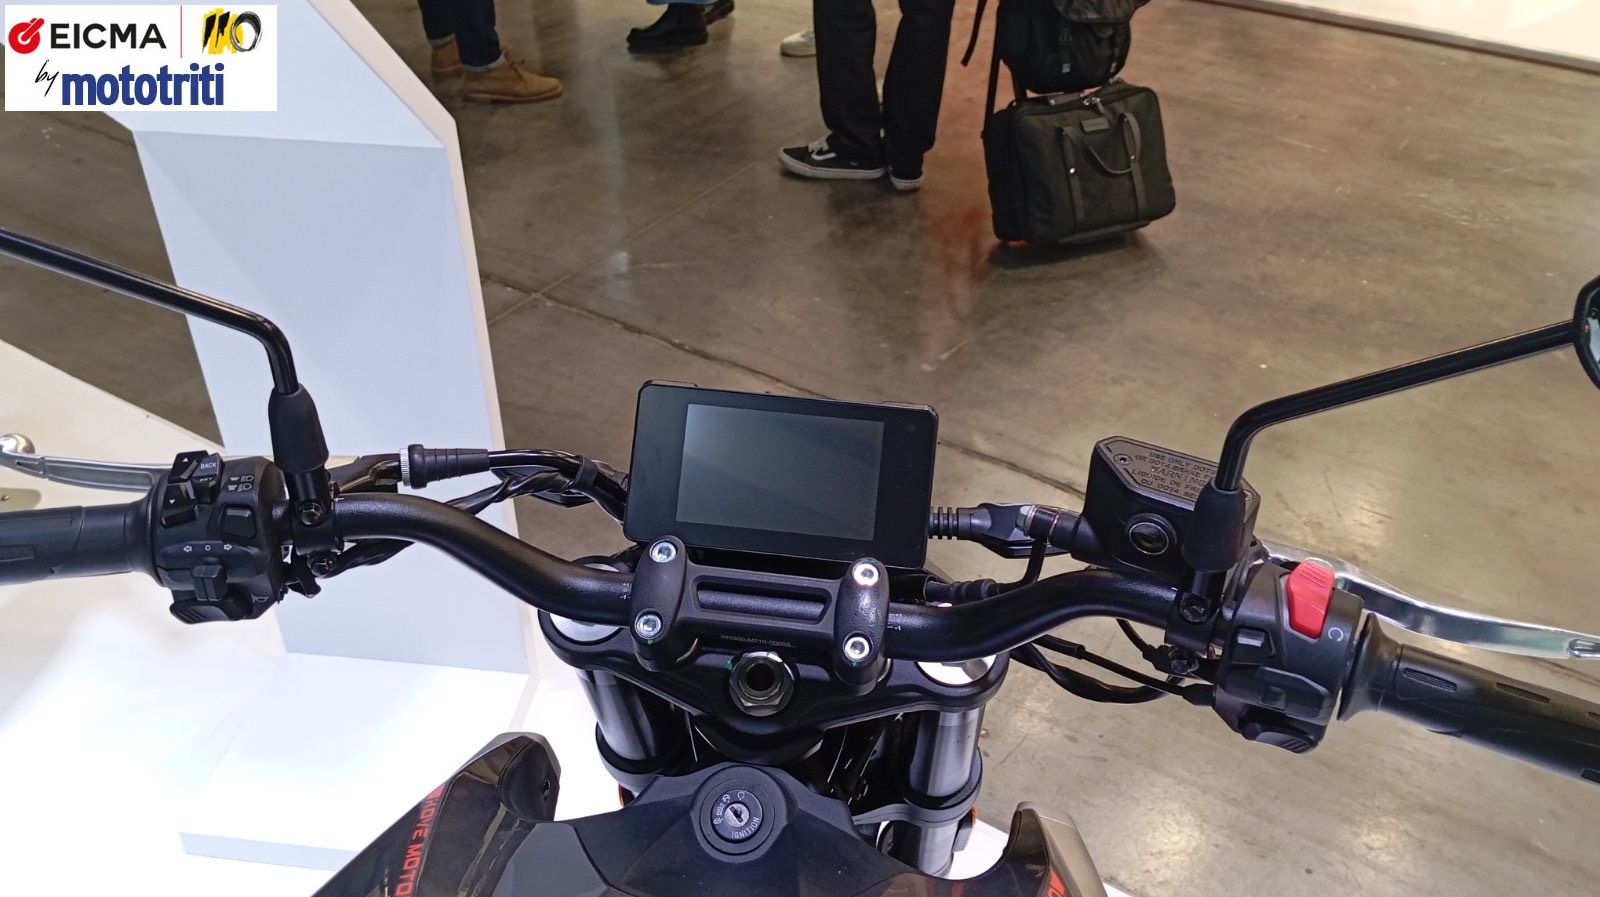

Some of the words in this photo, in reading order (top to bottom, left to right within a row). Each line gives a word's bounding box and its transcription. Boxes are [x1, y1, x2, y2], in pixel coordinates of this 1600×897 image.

[200, 461, 217, 470] BACK
[1150, 452, 1166, 460] USE
[1168, 458, 1191, 468] ONLY
[1151, 465, 1207, 487] WARNING
[1169, 480, 1182, 488] DE
[731, 816, 760, 839] IGNITION
